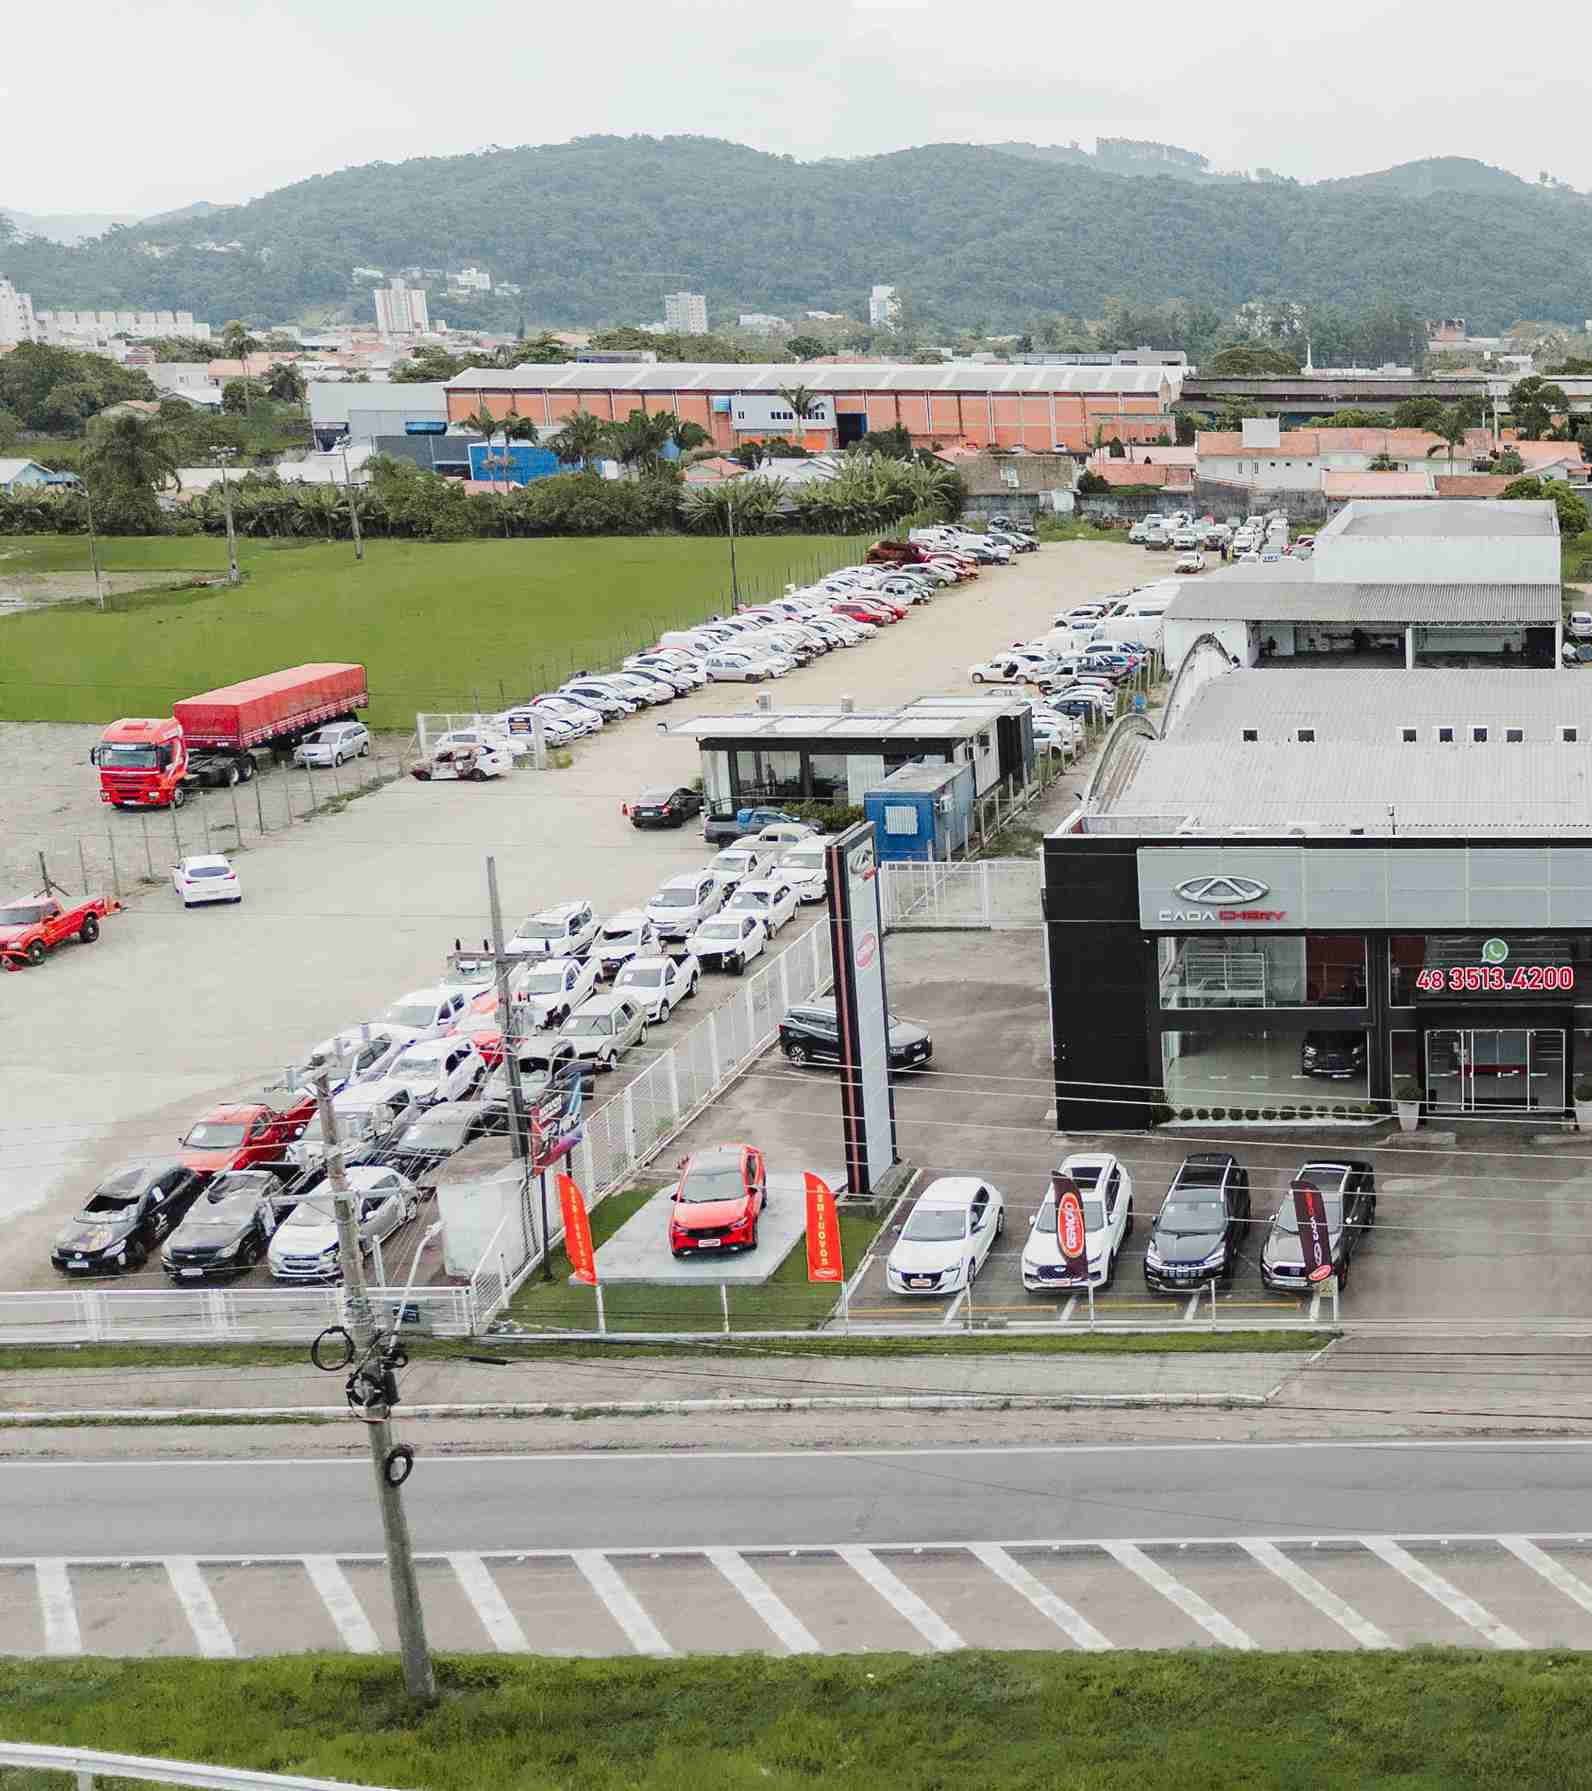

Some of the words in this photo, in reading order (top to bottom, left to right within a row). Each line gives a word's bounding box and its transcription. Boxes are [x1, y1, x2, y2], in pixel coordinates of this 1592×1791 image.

[1218, 910, 1288, 922] CHERY
[1416, 969, 1445, 990] 48
[1449, 966, 1574, 991] 3513.4200
